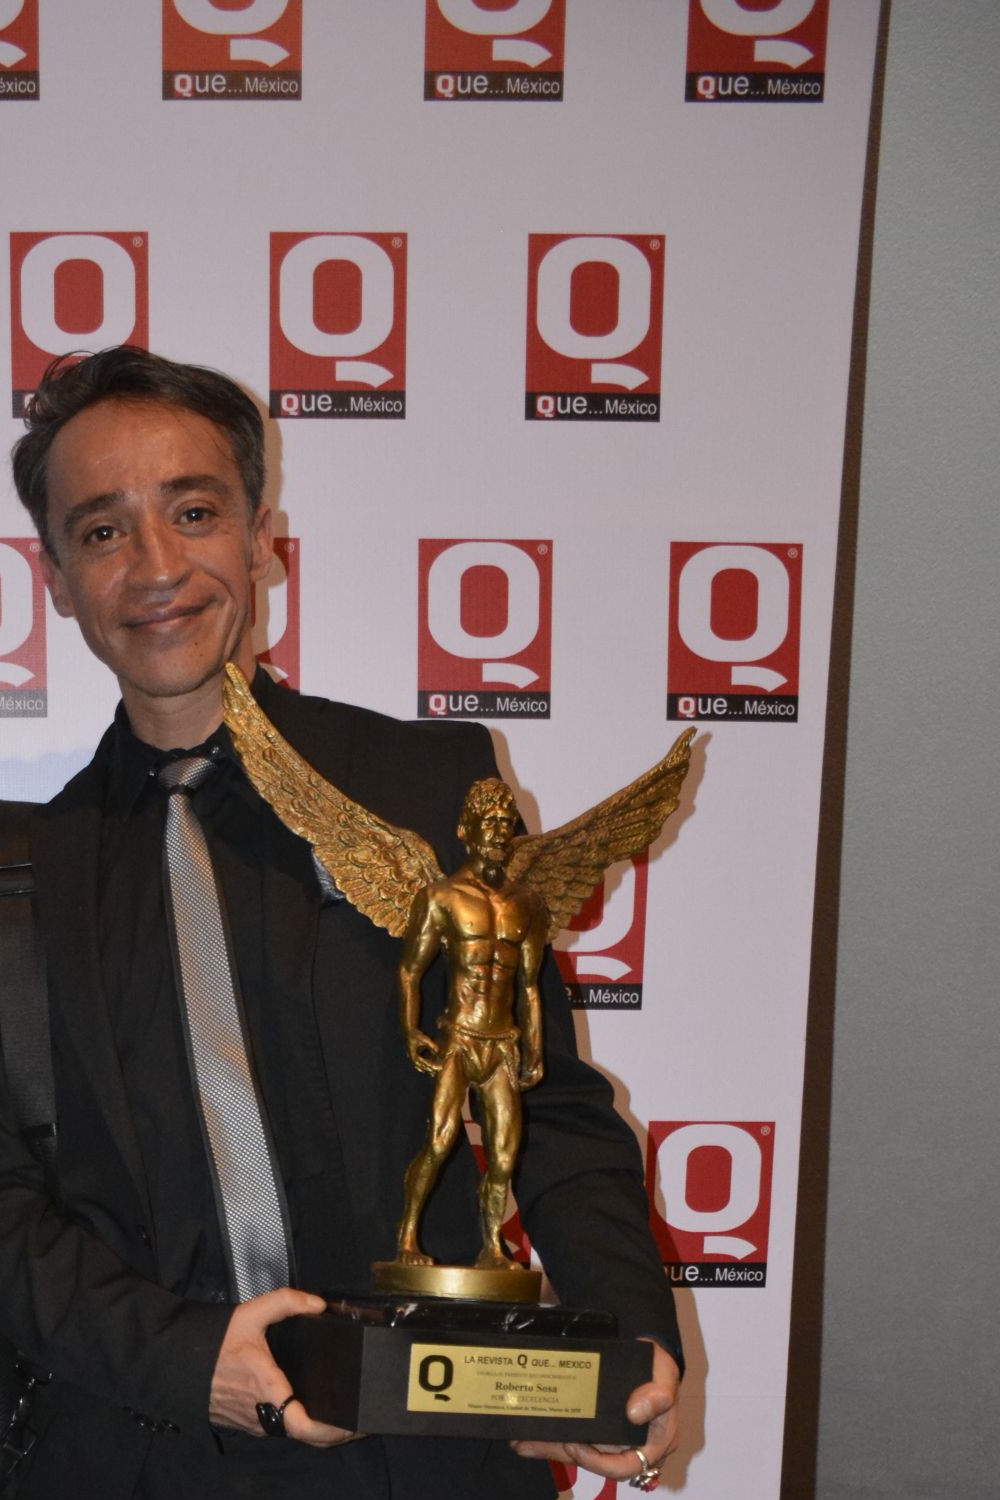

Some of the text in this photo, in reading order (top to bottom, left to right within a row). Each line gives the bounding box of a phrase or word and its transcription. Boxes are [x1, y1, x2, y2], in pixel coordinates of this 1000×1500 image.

[280, 235, 394, 387] Q
[537, 237, 651, 390] Q
[428, 542, 539, 688] Q
[678, 545, 789, 691] Q
[656, 1124, 762, 1259] Q
[419, 1355, 453, 1401] Q
[464, 1356, 475, 1365] LA
[477, 1356, 513, 1365] REVISTA
[517, 1354, 528, 1368] Q
[495, 1382, 558, 1393] Roberto Sosa
